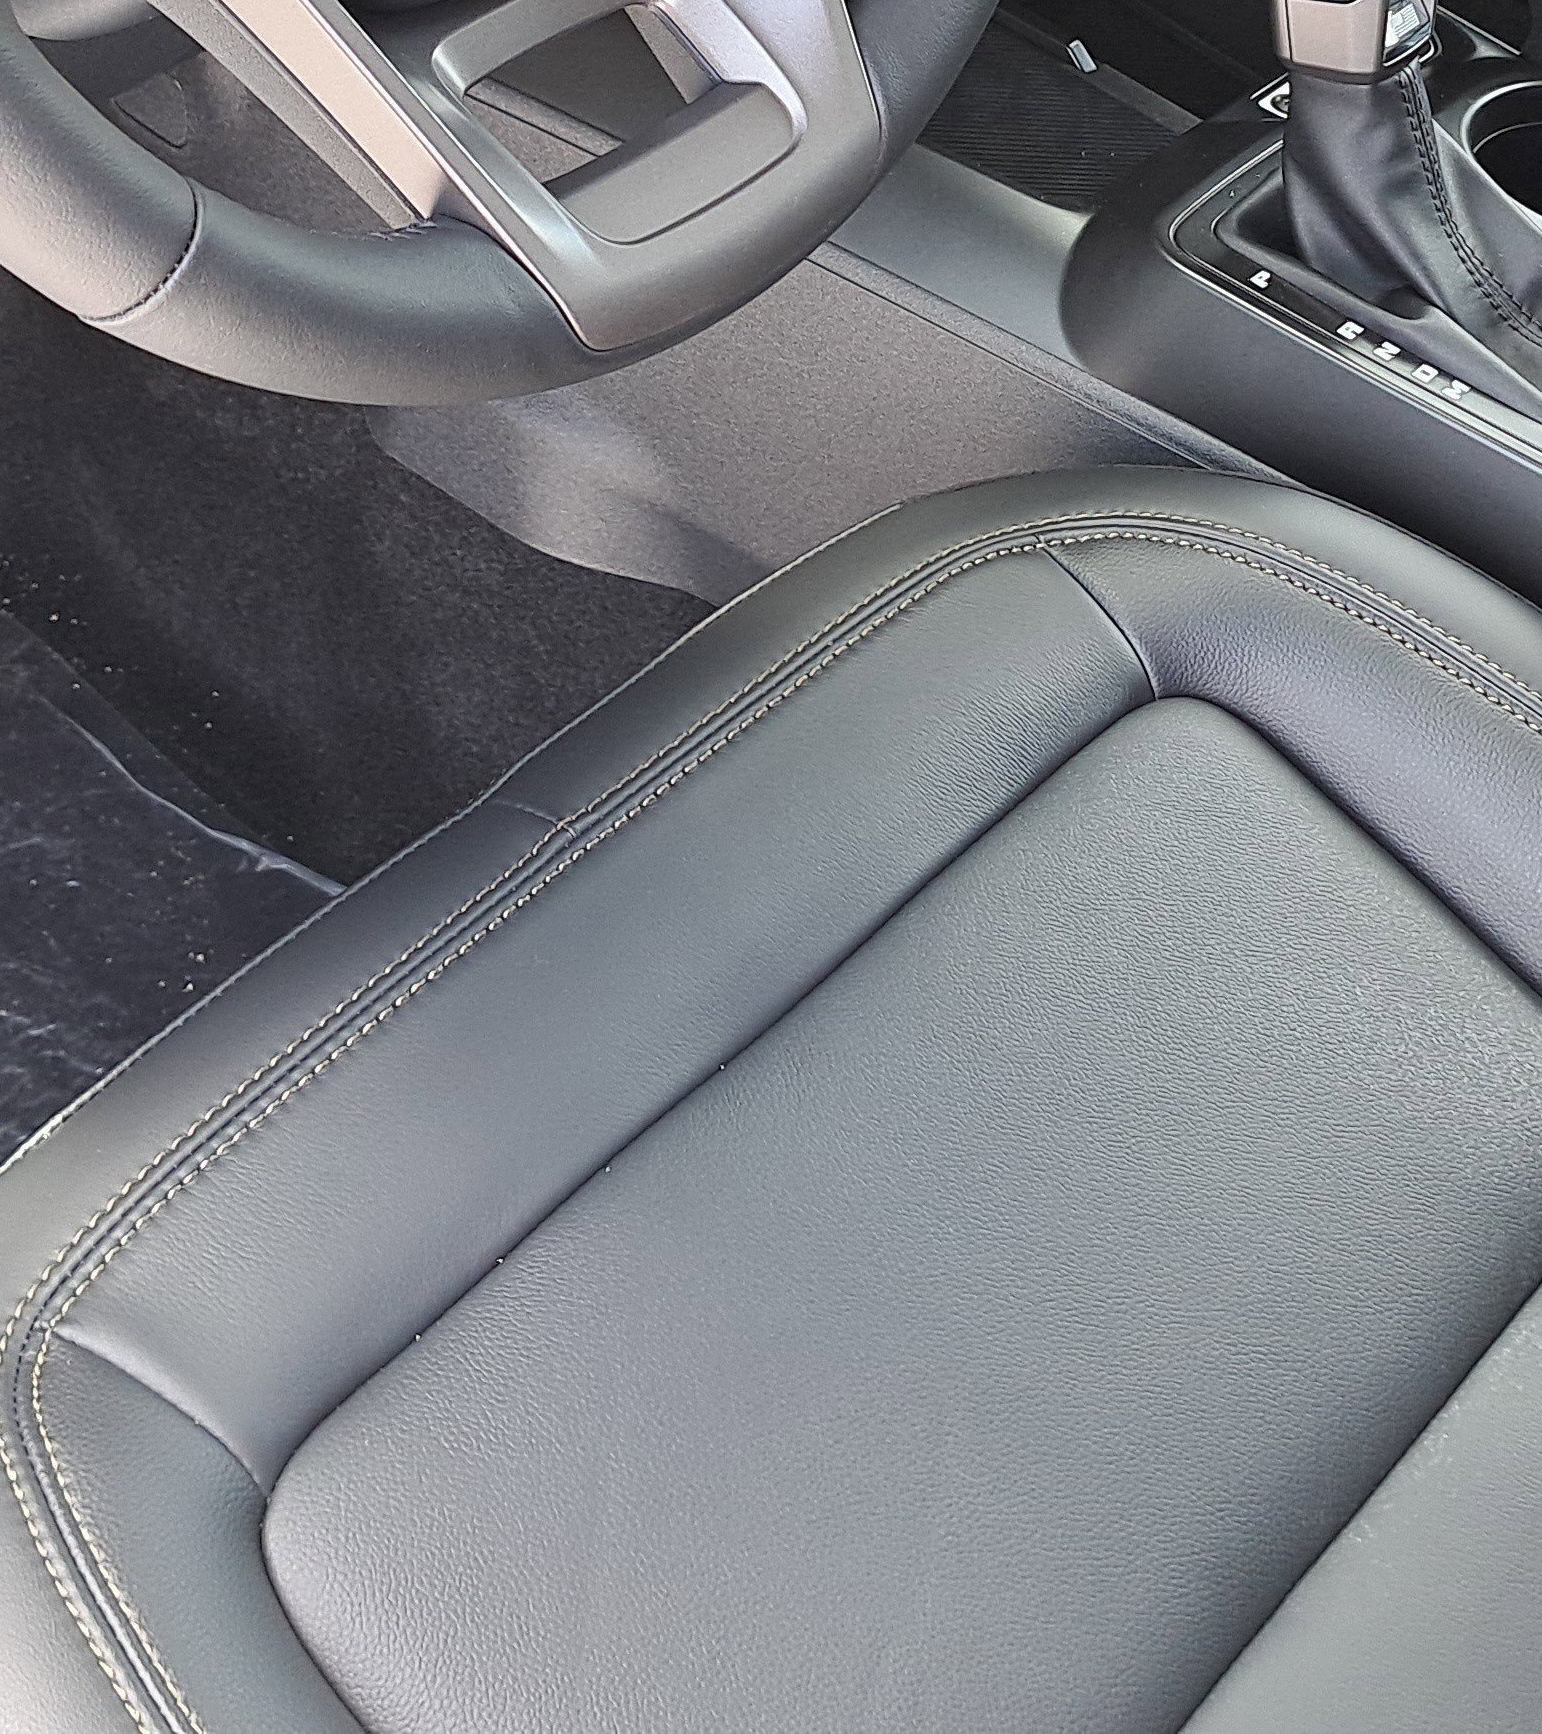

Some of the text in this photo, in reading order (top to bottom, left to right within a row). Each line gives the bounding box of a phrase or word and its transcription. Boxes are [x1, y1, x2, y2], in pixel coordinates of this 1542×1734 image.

[1249, 269, 1271, 289] P
[1373, 341, 1401, 362] N
[1411, 364, 1439, 383] D
[1441, 379, 1472, 400] M
